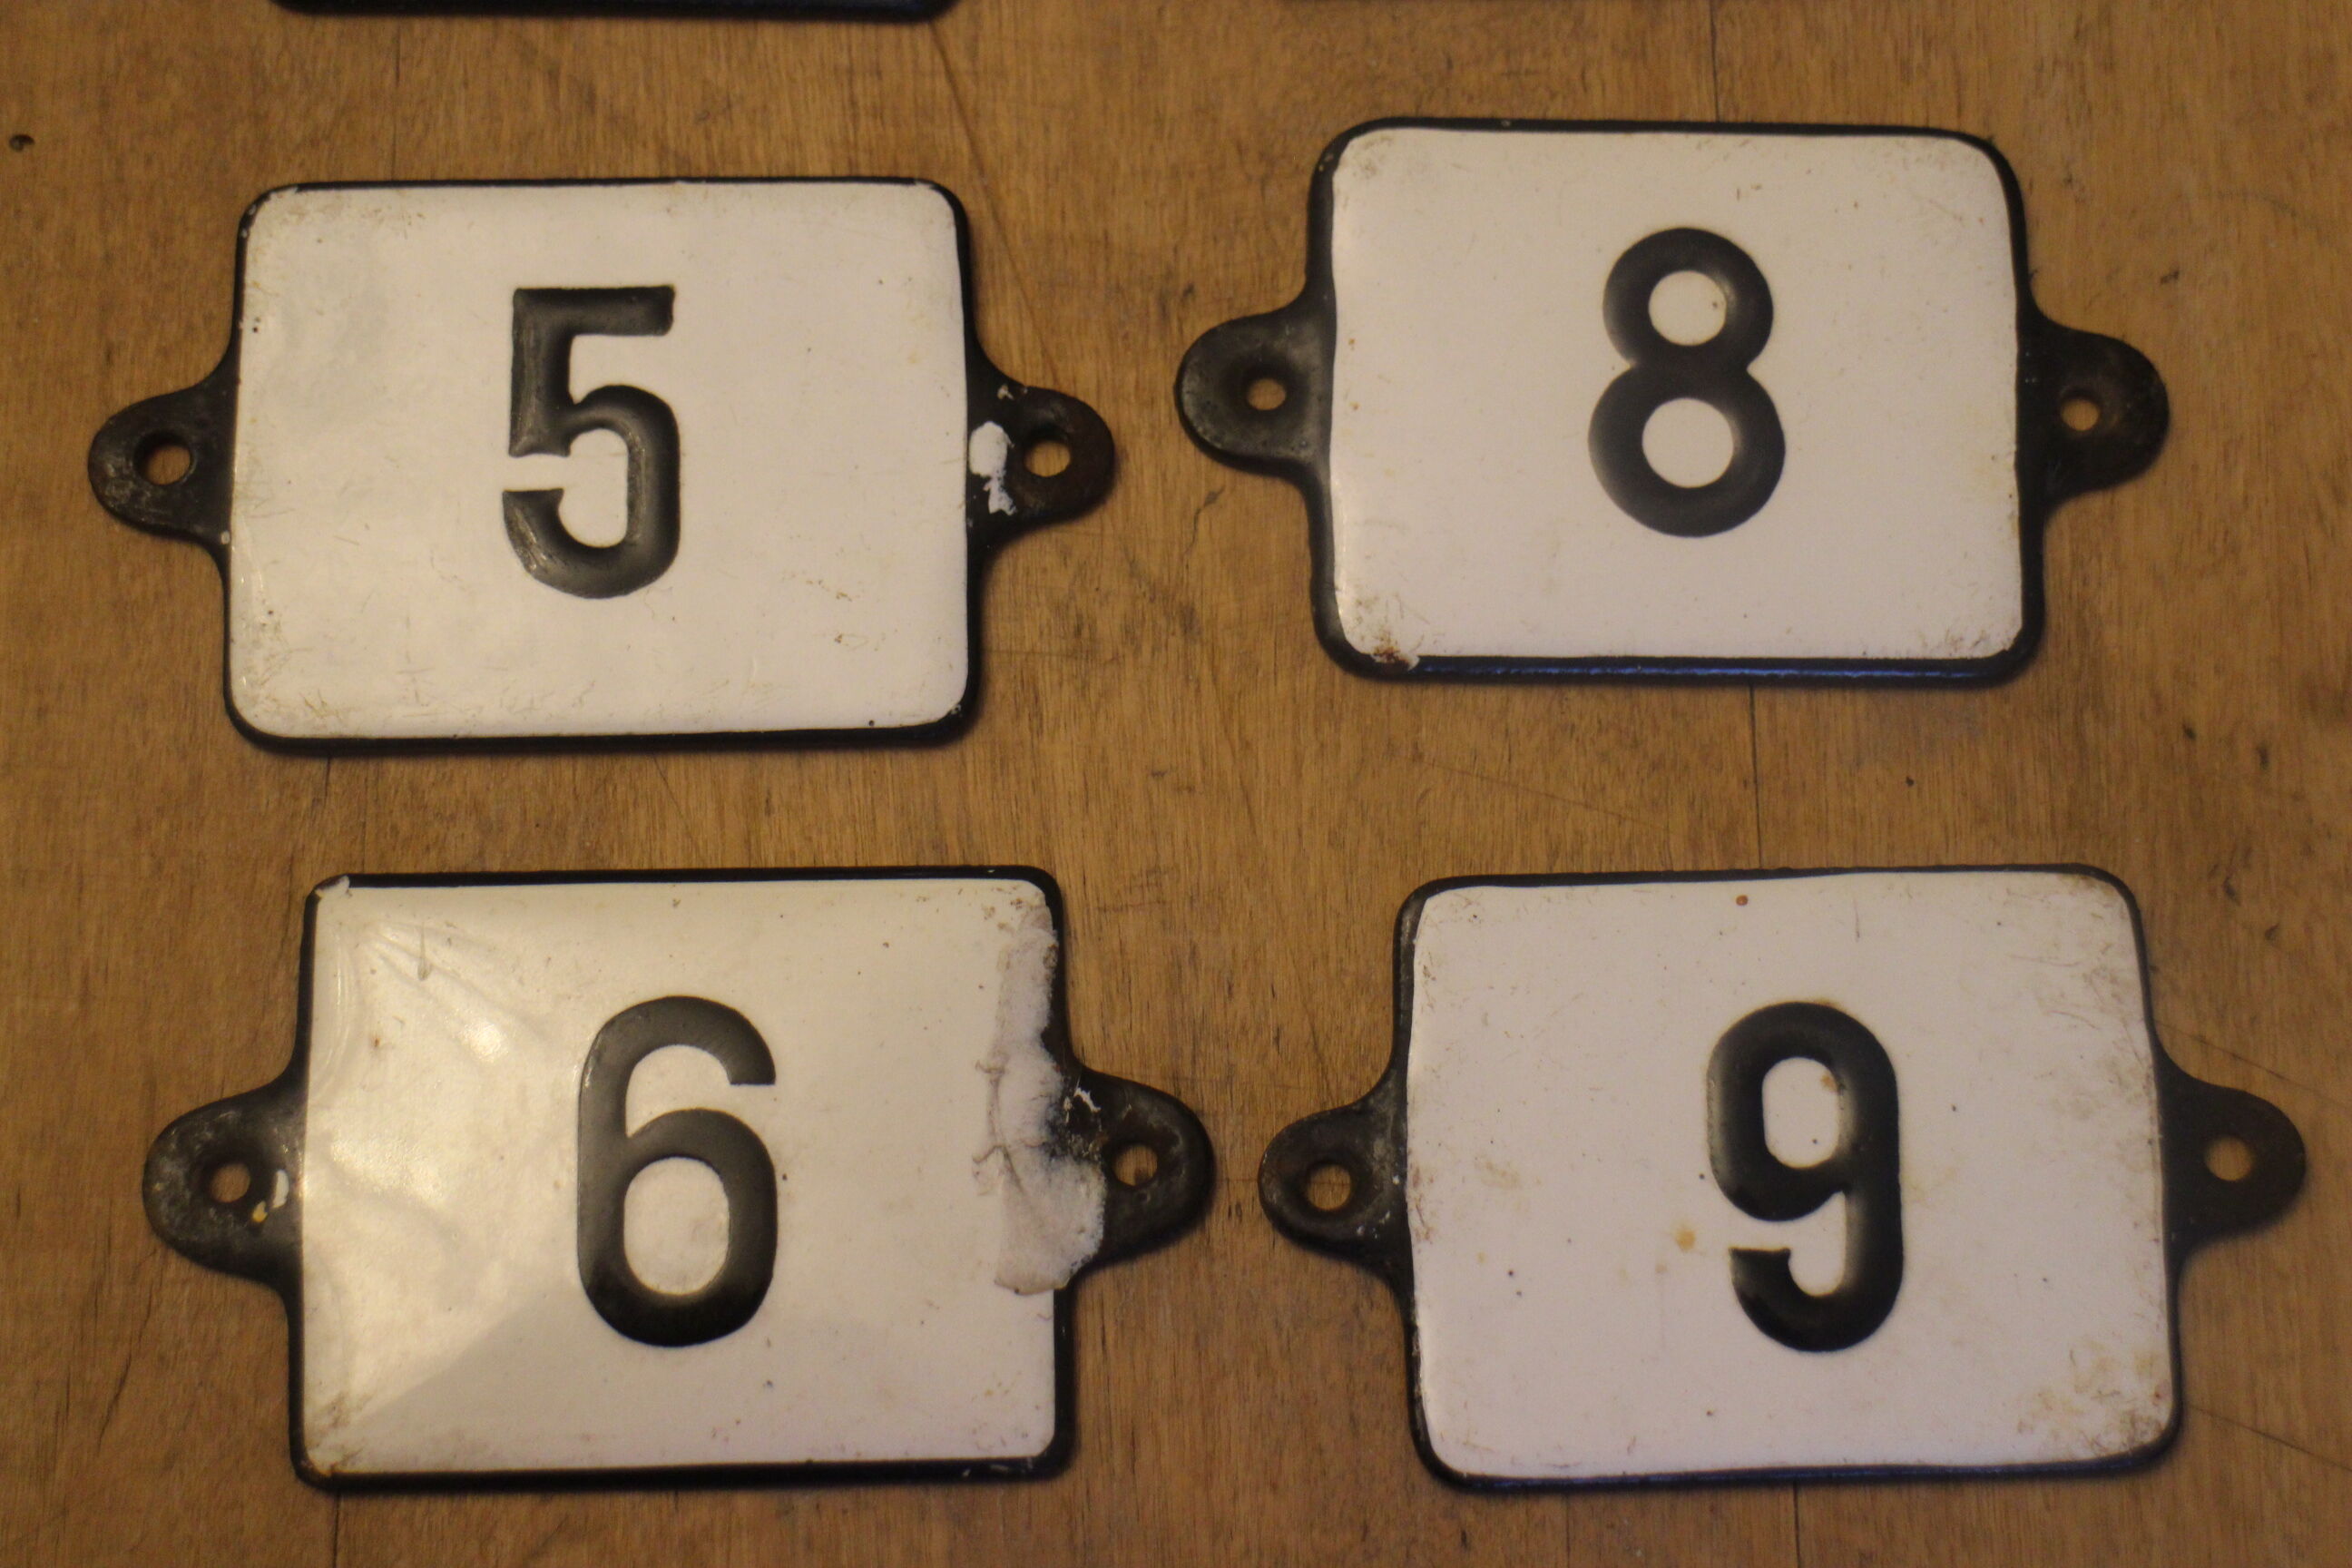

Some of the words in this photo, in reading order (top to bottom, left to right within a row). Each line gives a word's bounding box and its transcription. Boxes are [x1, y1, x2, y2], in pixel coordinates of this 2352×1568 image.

[503, 285, 681, 599] 5
[1590, 227, 1786, 537] 8
[577, 995, 778, 1349] 6
[1708, 1002, 1906, 1354] 9
